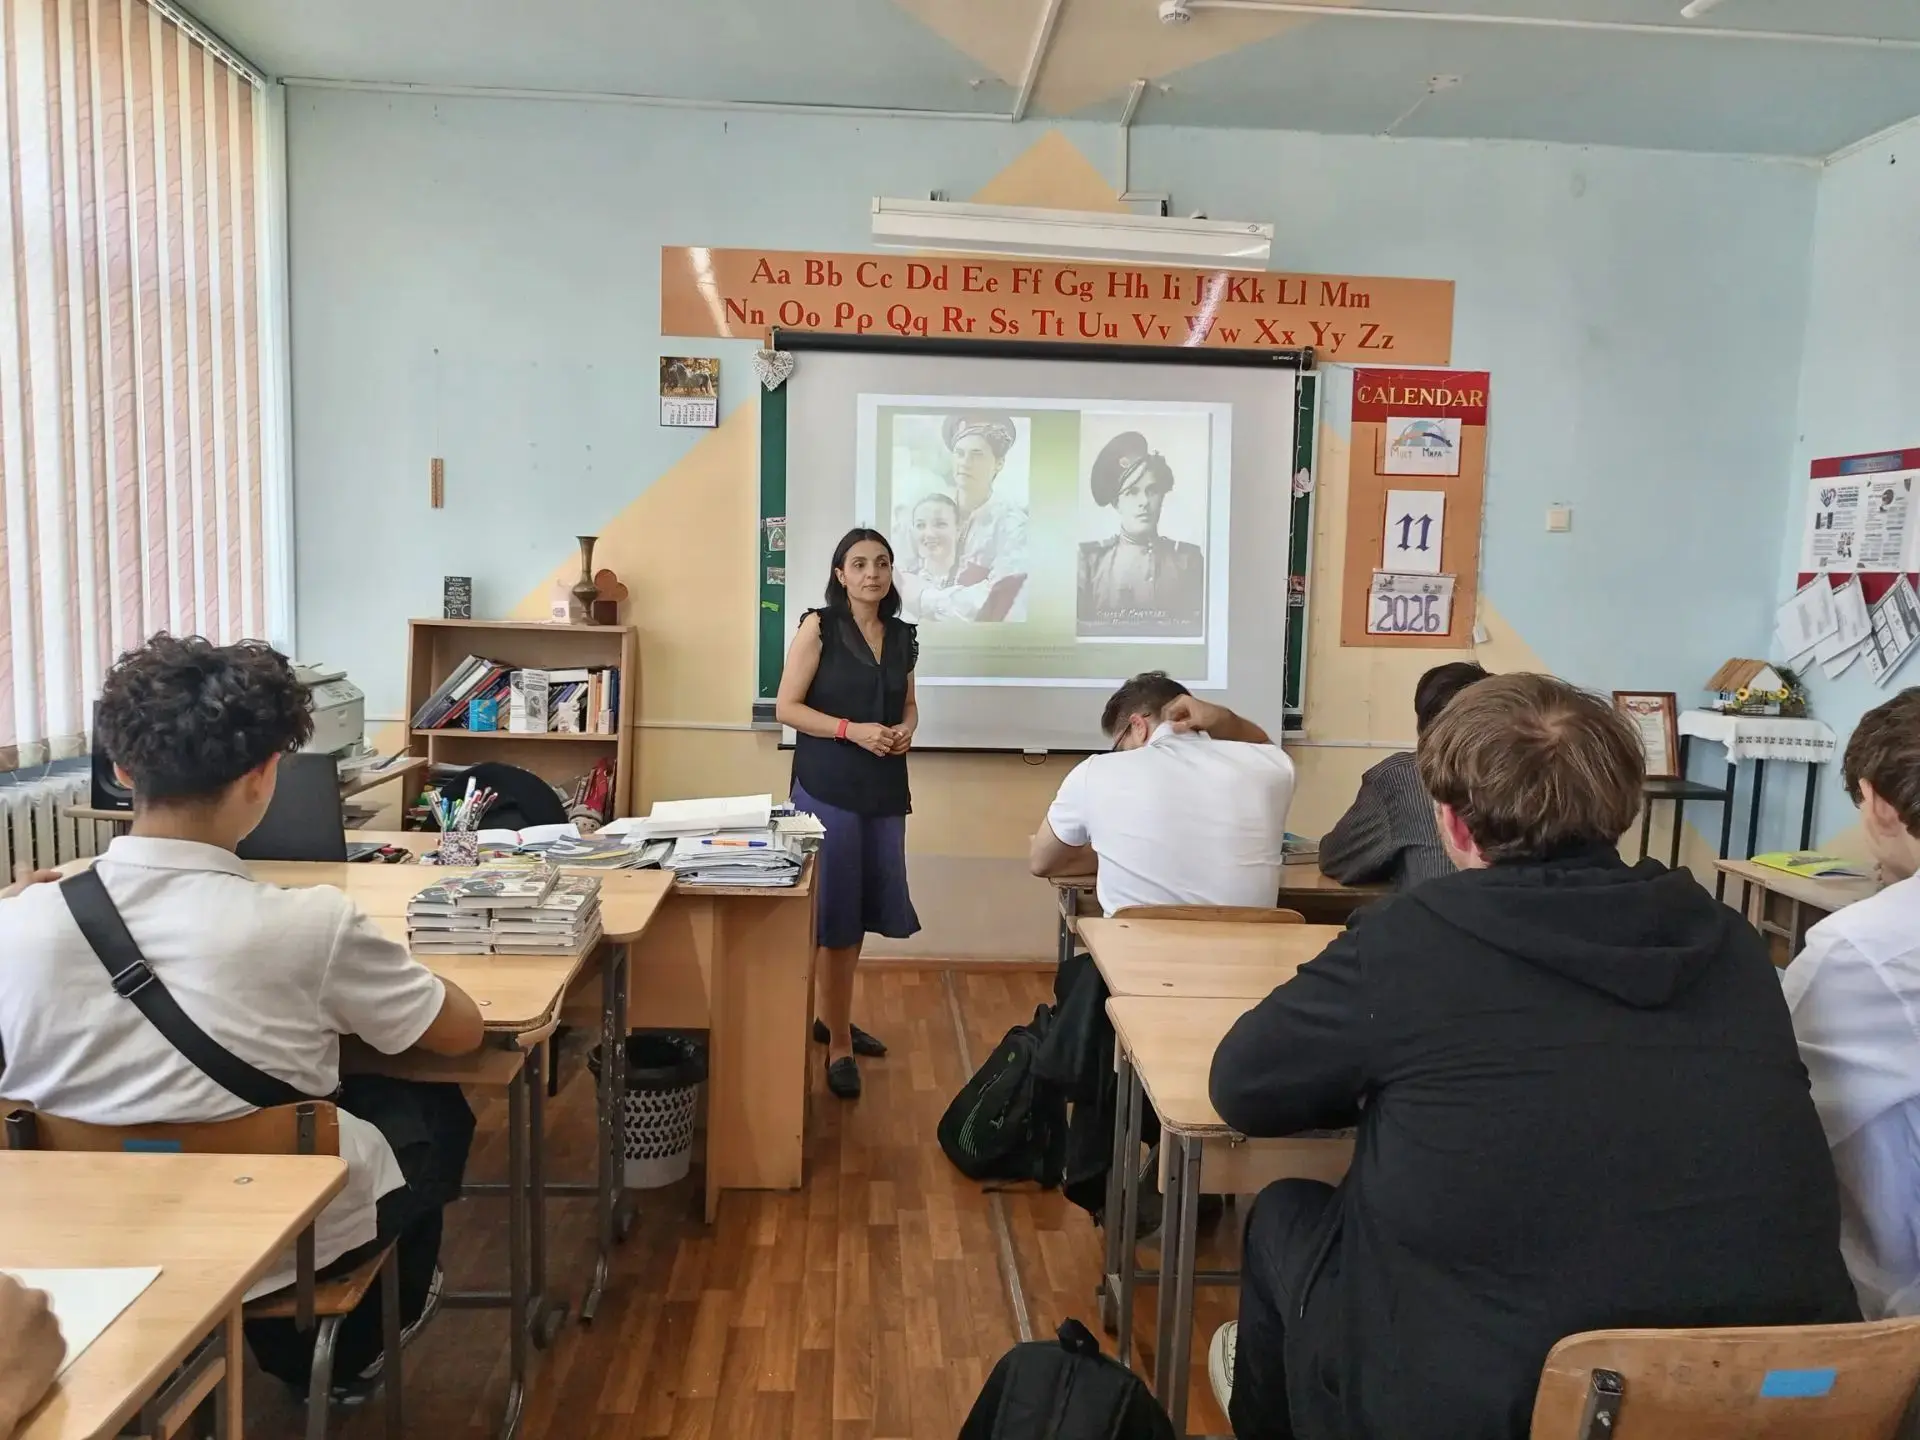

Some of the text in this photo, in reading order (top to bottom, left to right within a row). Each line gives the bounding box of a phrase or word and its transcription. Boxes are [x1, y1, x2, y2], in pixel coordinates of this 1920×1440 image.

[750, 257, 792, 285] Aa
[804, 259, 843, 287] Bb
[856, 261, 893, 289] Cc
[906, 263, 949, 291] Dd
[961, 265, 999, 293] Ee
[1011, 267, 1043, 294] Ff
[1054, 268, 1095, 301] Gg
[1107, 271, 1150, 300] Hh
[1161, 273, 1181, 301] Ii
[1225, 275, 1266, 304] Kk
[1276, 278, 1307, 306] Ll
[1319, 281, 1371, 309] Mm
[724, 297, 1395, 354] Nn Oo Pp Qq Rr Ss Tt Uu Vv Ww Xx Yy Zz
[1356, 385, 1485, 408] CALENDAR
[1394, 513, 1434, 552] 11
[1376, 594, 1441, 633] 2026
